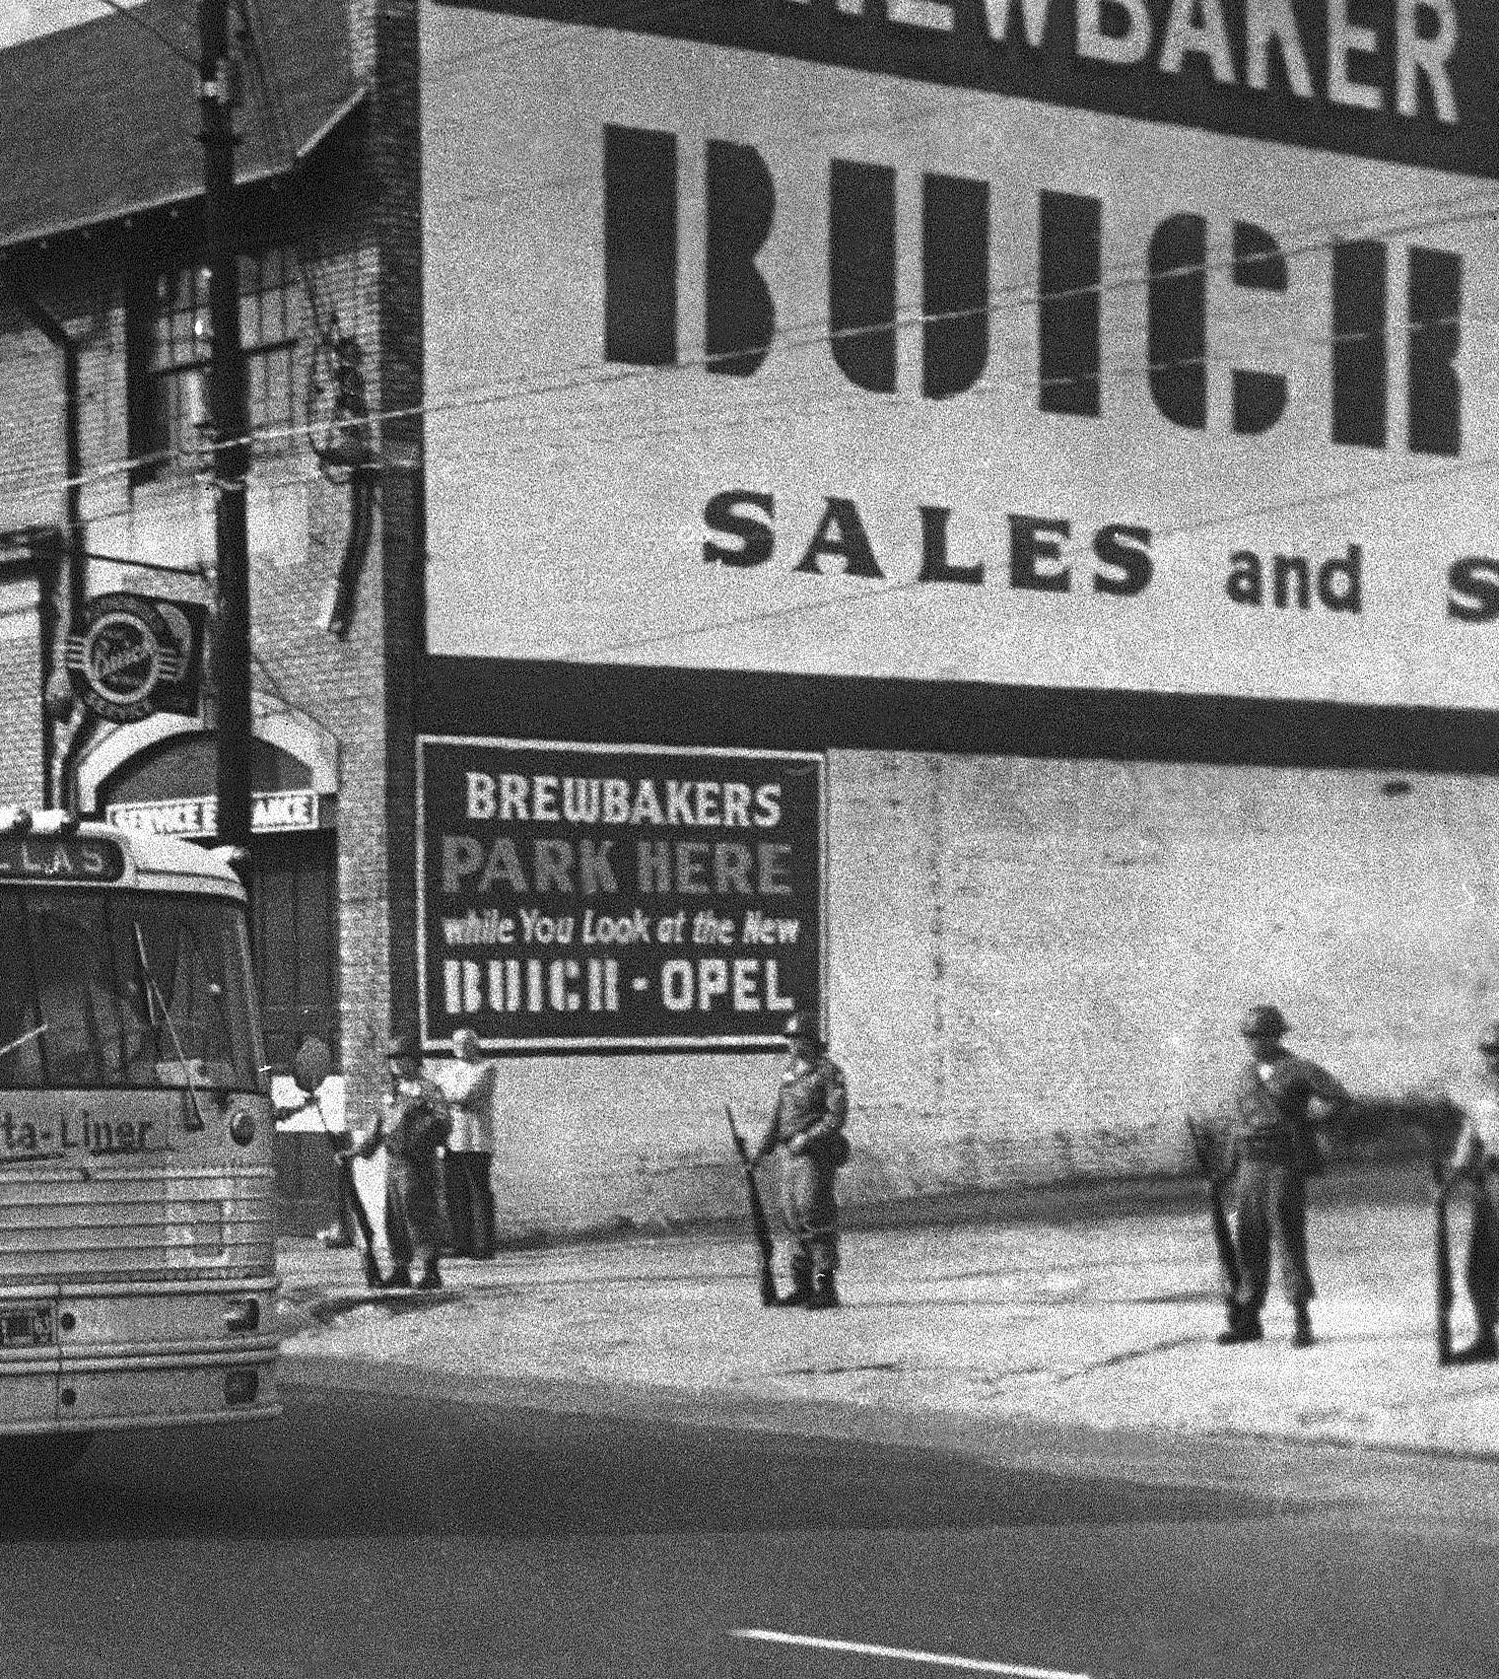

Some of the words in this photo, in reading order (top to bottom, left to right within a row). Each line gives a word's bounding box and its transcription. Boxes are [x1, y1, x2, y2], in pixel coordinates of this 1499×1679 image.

[603, 121, 1463, 458] BUICK
[701, 488, 1155, 598] SALES
[1224, 543, 1363, 615] and
[465, 771, 782, 828] BREWBAKERS
[441, 834, 619, 894] PARK
[636, 840, 794, 895] HERE
[441, 908, 515, 945] while
[518, 908, 575, 945] You
[582, 908, 651, 945] Look
[656, 910, 688, 944] at
[691, 910, 735, 945] the
[741, 910, 800, 945] New
